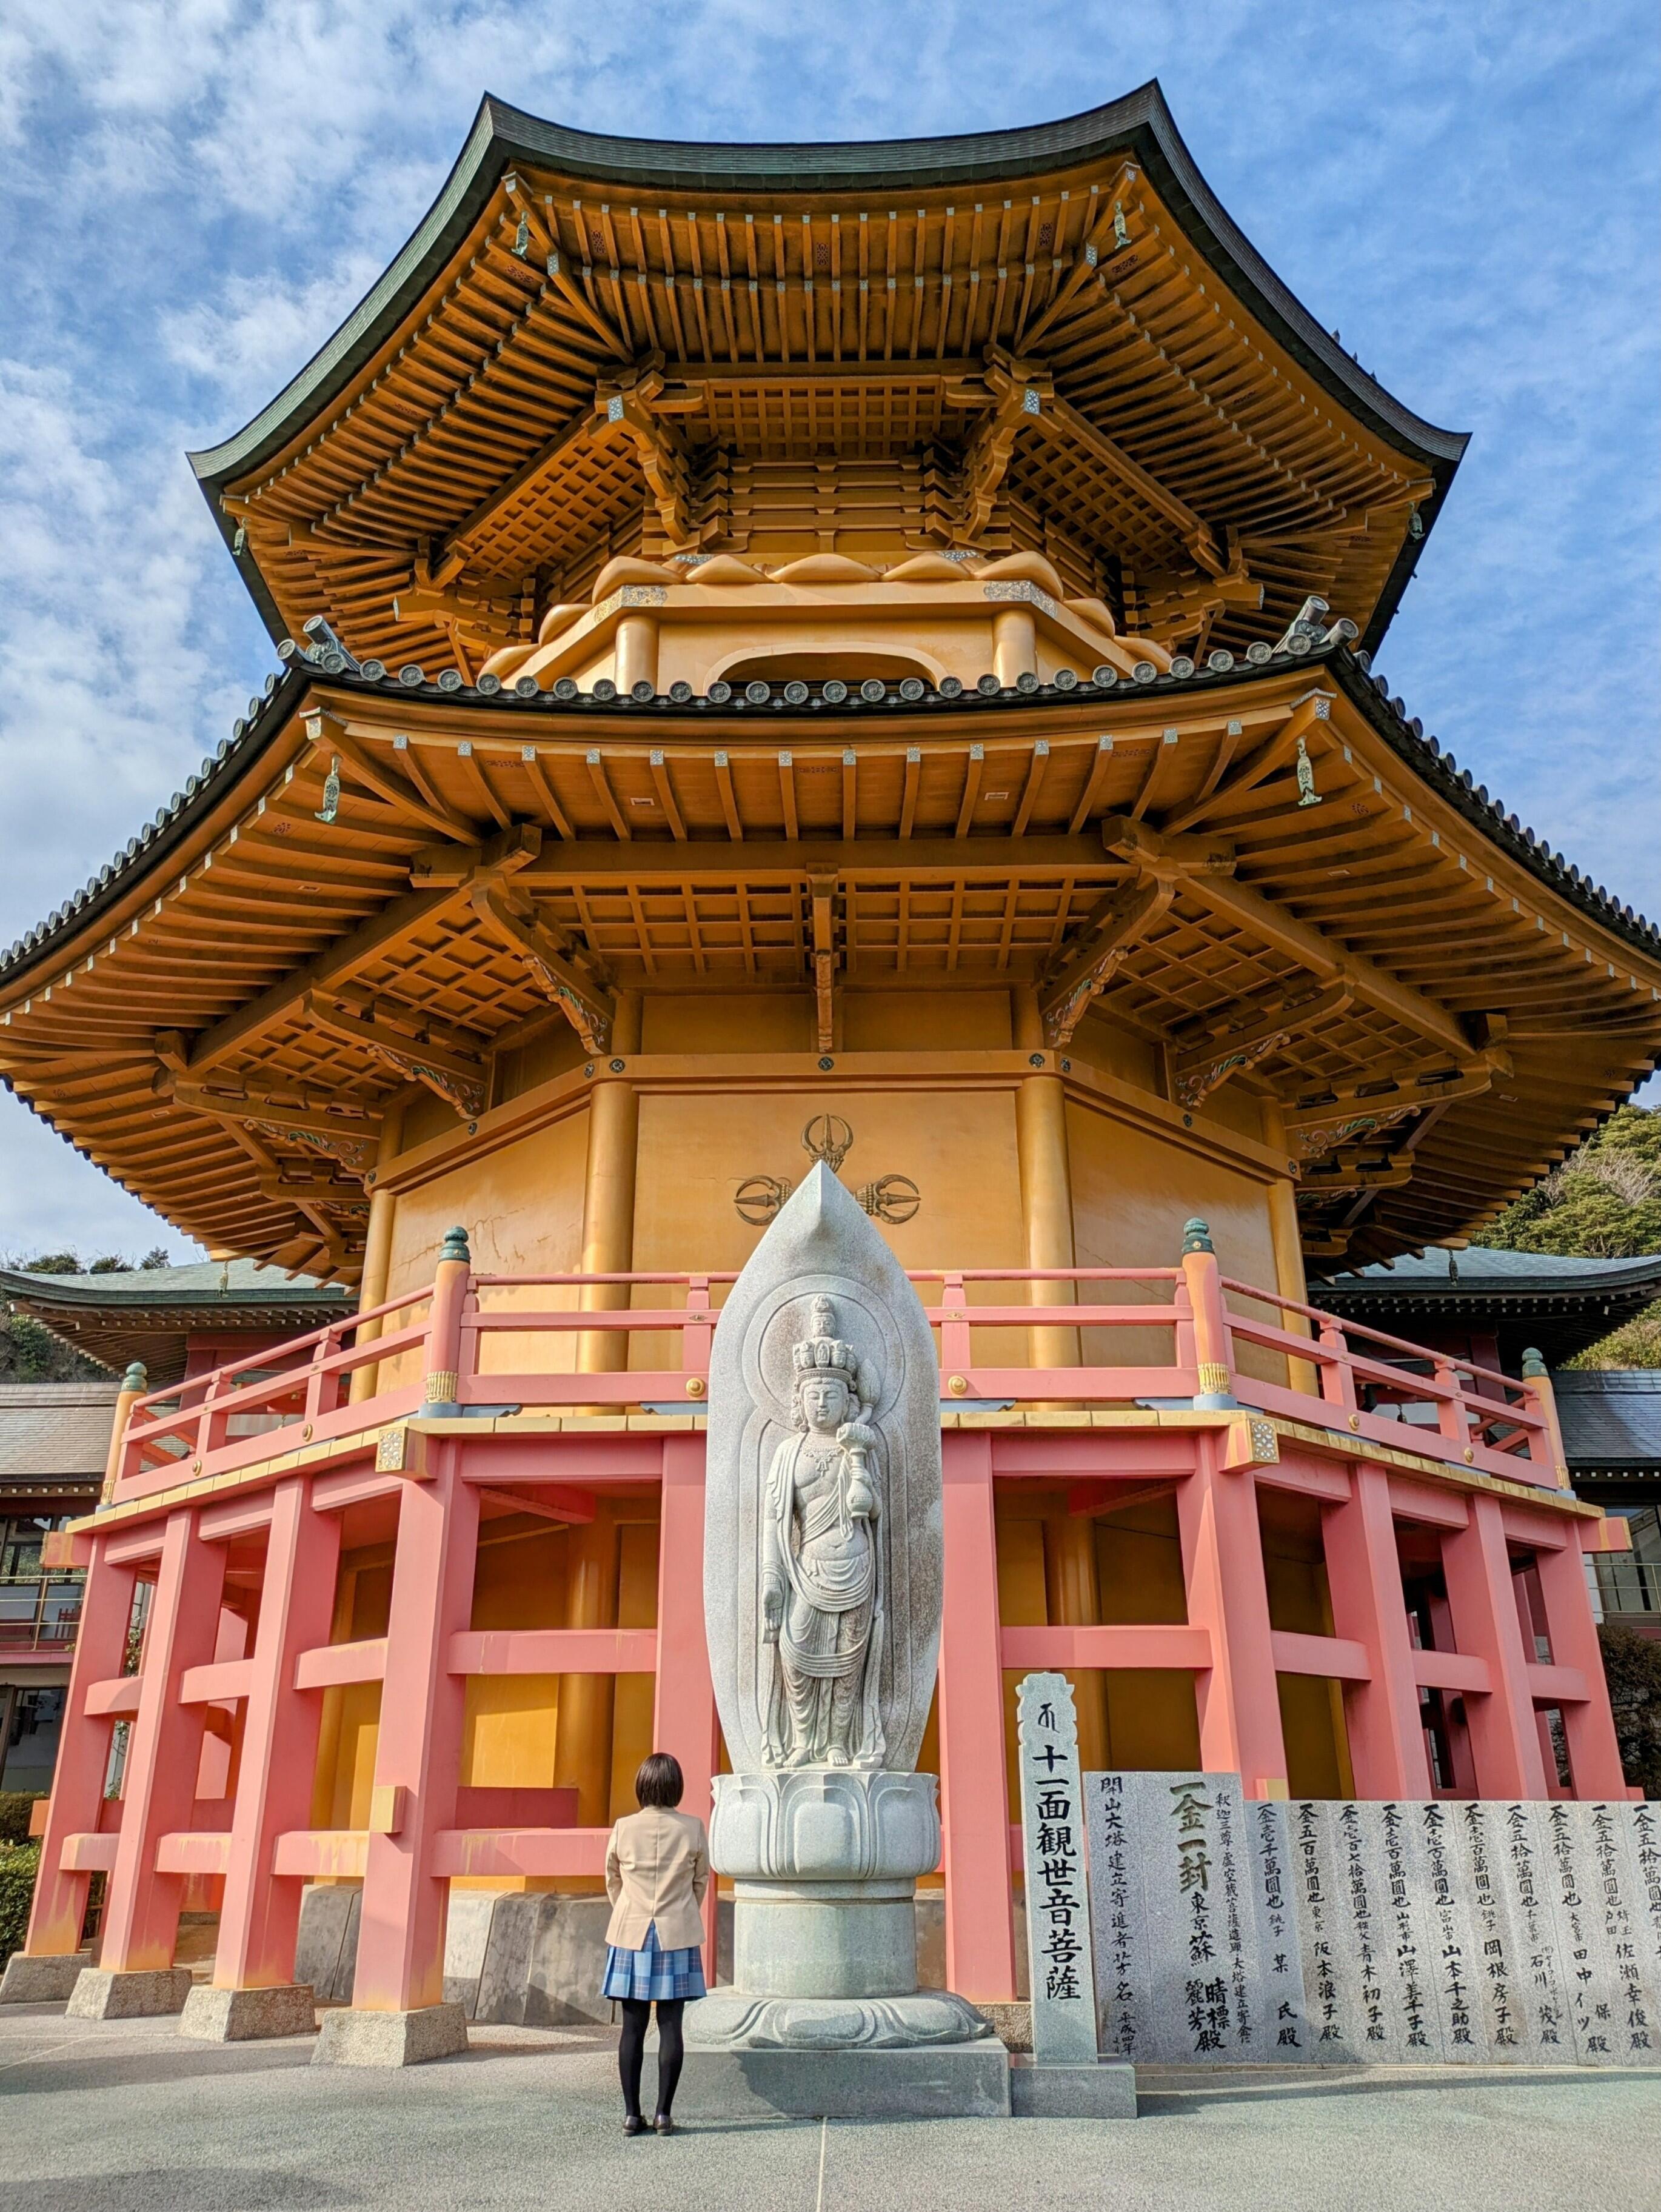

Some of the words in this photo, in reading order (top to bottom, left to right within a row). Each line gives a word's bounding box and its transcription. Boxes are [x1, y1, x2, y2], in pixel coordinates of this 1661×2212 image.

[1032, 1744, 1083, 2000] 十一面観世音菩薩
[1169, 1781, 1214, 1894] 一金一封
[1356, 1943, 1387, 2042] 青木初子殿
[1441, 1945, 1476, 2045] 山本千之助殿
[1483, 1939, 1519, 2046] 岡根房子殿
